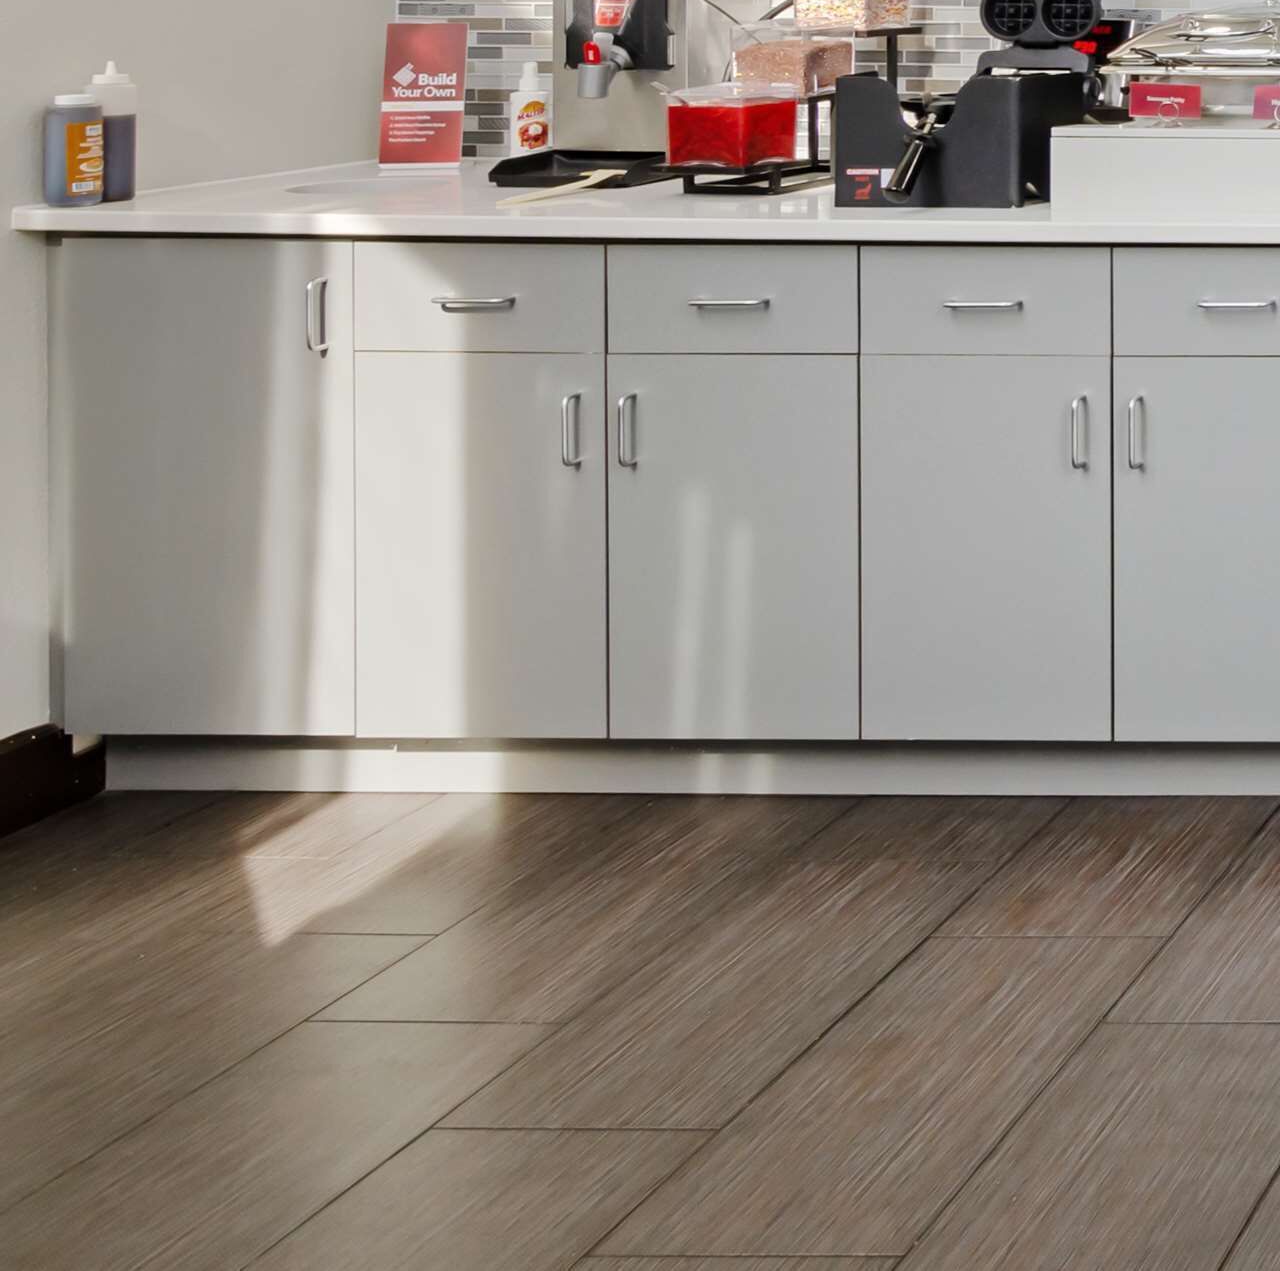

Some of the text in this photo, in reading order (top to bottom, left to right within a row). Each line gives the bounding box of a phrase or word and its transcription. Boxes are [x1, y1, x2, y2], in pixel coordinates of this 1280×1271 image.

[417, 72, 457, 86] Build
[391, 86, 456, 98] Your Own
